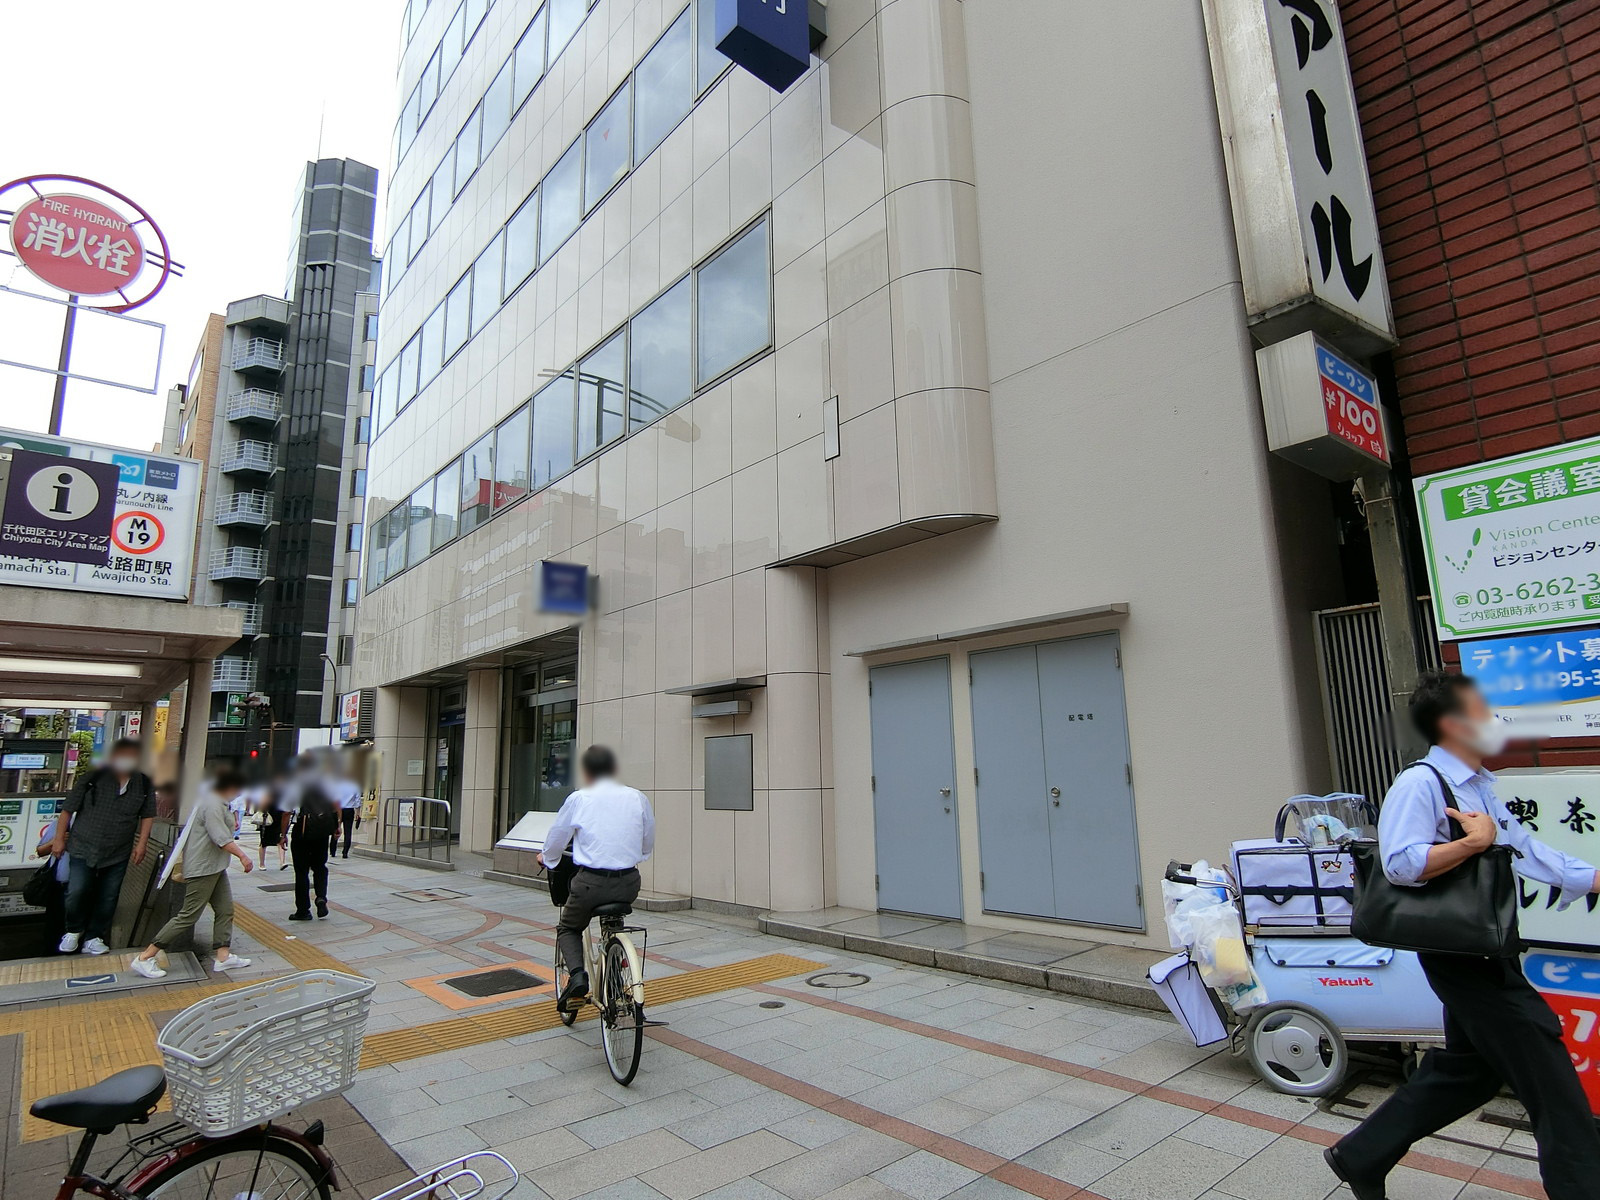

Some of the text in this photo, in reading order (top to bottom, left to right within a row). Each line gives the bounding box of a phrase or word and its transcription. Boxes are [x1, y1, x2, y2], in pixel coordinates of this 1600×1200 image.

[42, 198, 129, 233] FIRE HYDRANT
[22, 212, 136, 277] 消火栓
[1324, 356, 1367, 394] ビーワン
[1325, 390, 1377, 436] ¥100
[1336, 421, 1366, 447] ショップ
[116, 488, 169, 504] 丸ノ内線
[116, 499, 174, 512] arunouchi Line
[3, 523, 110, 544] 千代田区エリアマップ
[130, 518, 147, 531] M
[1489, 524, 1543, 543] Vision
[2, 533, 108, 553] Chiyoda City Area Map
[127, 531, 150, 545] 19
[1491, 538, 1538, 553] KANDA
[1493, 540, 1600, 569] ビジョンセンタ
[47, 565, 71, 576] Sta.
[91, 570, 171, 586] Awajicho Sta.
[1458, 598, 1579, 623] ご内覧随時承ります
[1505, 796, 1597, 834] 喫茶
[1317, 976, 1375, 987] Yakult
